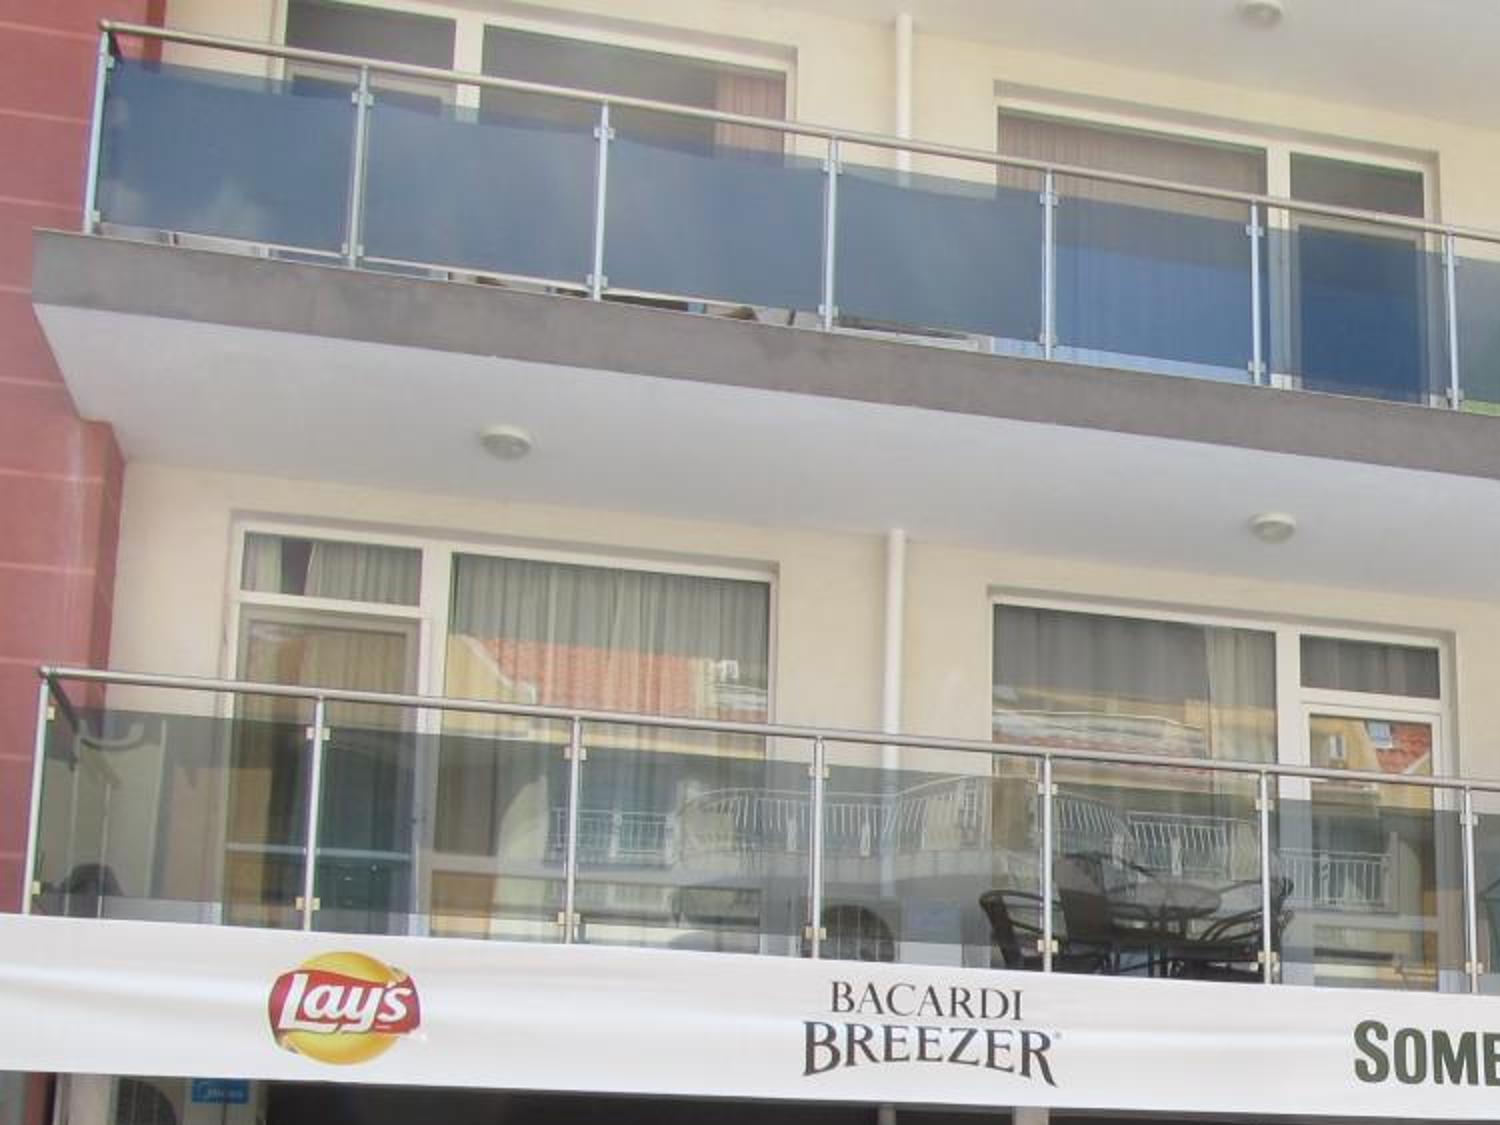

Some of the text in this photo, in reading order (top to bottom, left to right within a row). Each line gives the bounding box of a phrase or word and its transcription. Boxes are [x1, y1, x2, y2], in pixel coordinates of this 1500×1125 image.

[277, 972, 413, 1035] Lay's
[830, 980, 1024, 1021] BACARDI
[802, 1020, 1058, 1088] BREEZER
